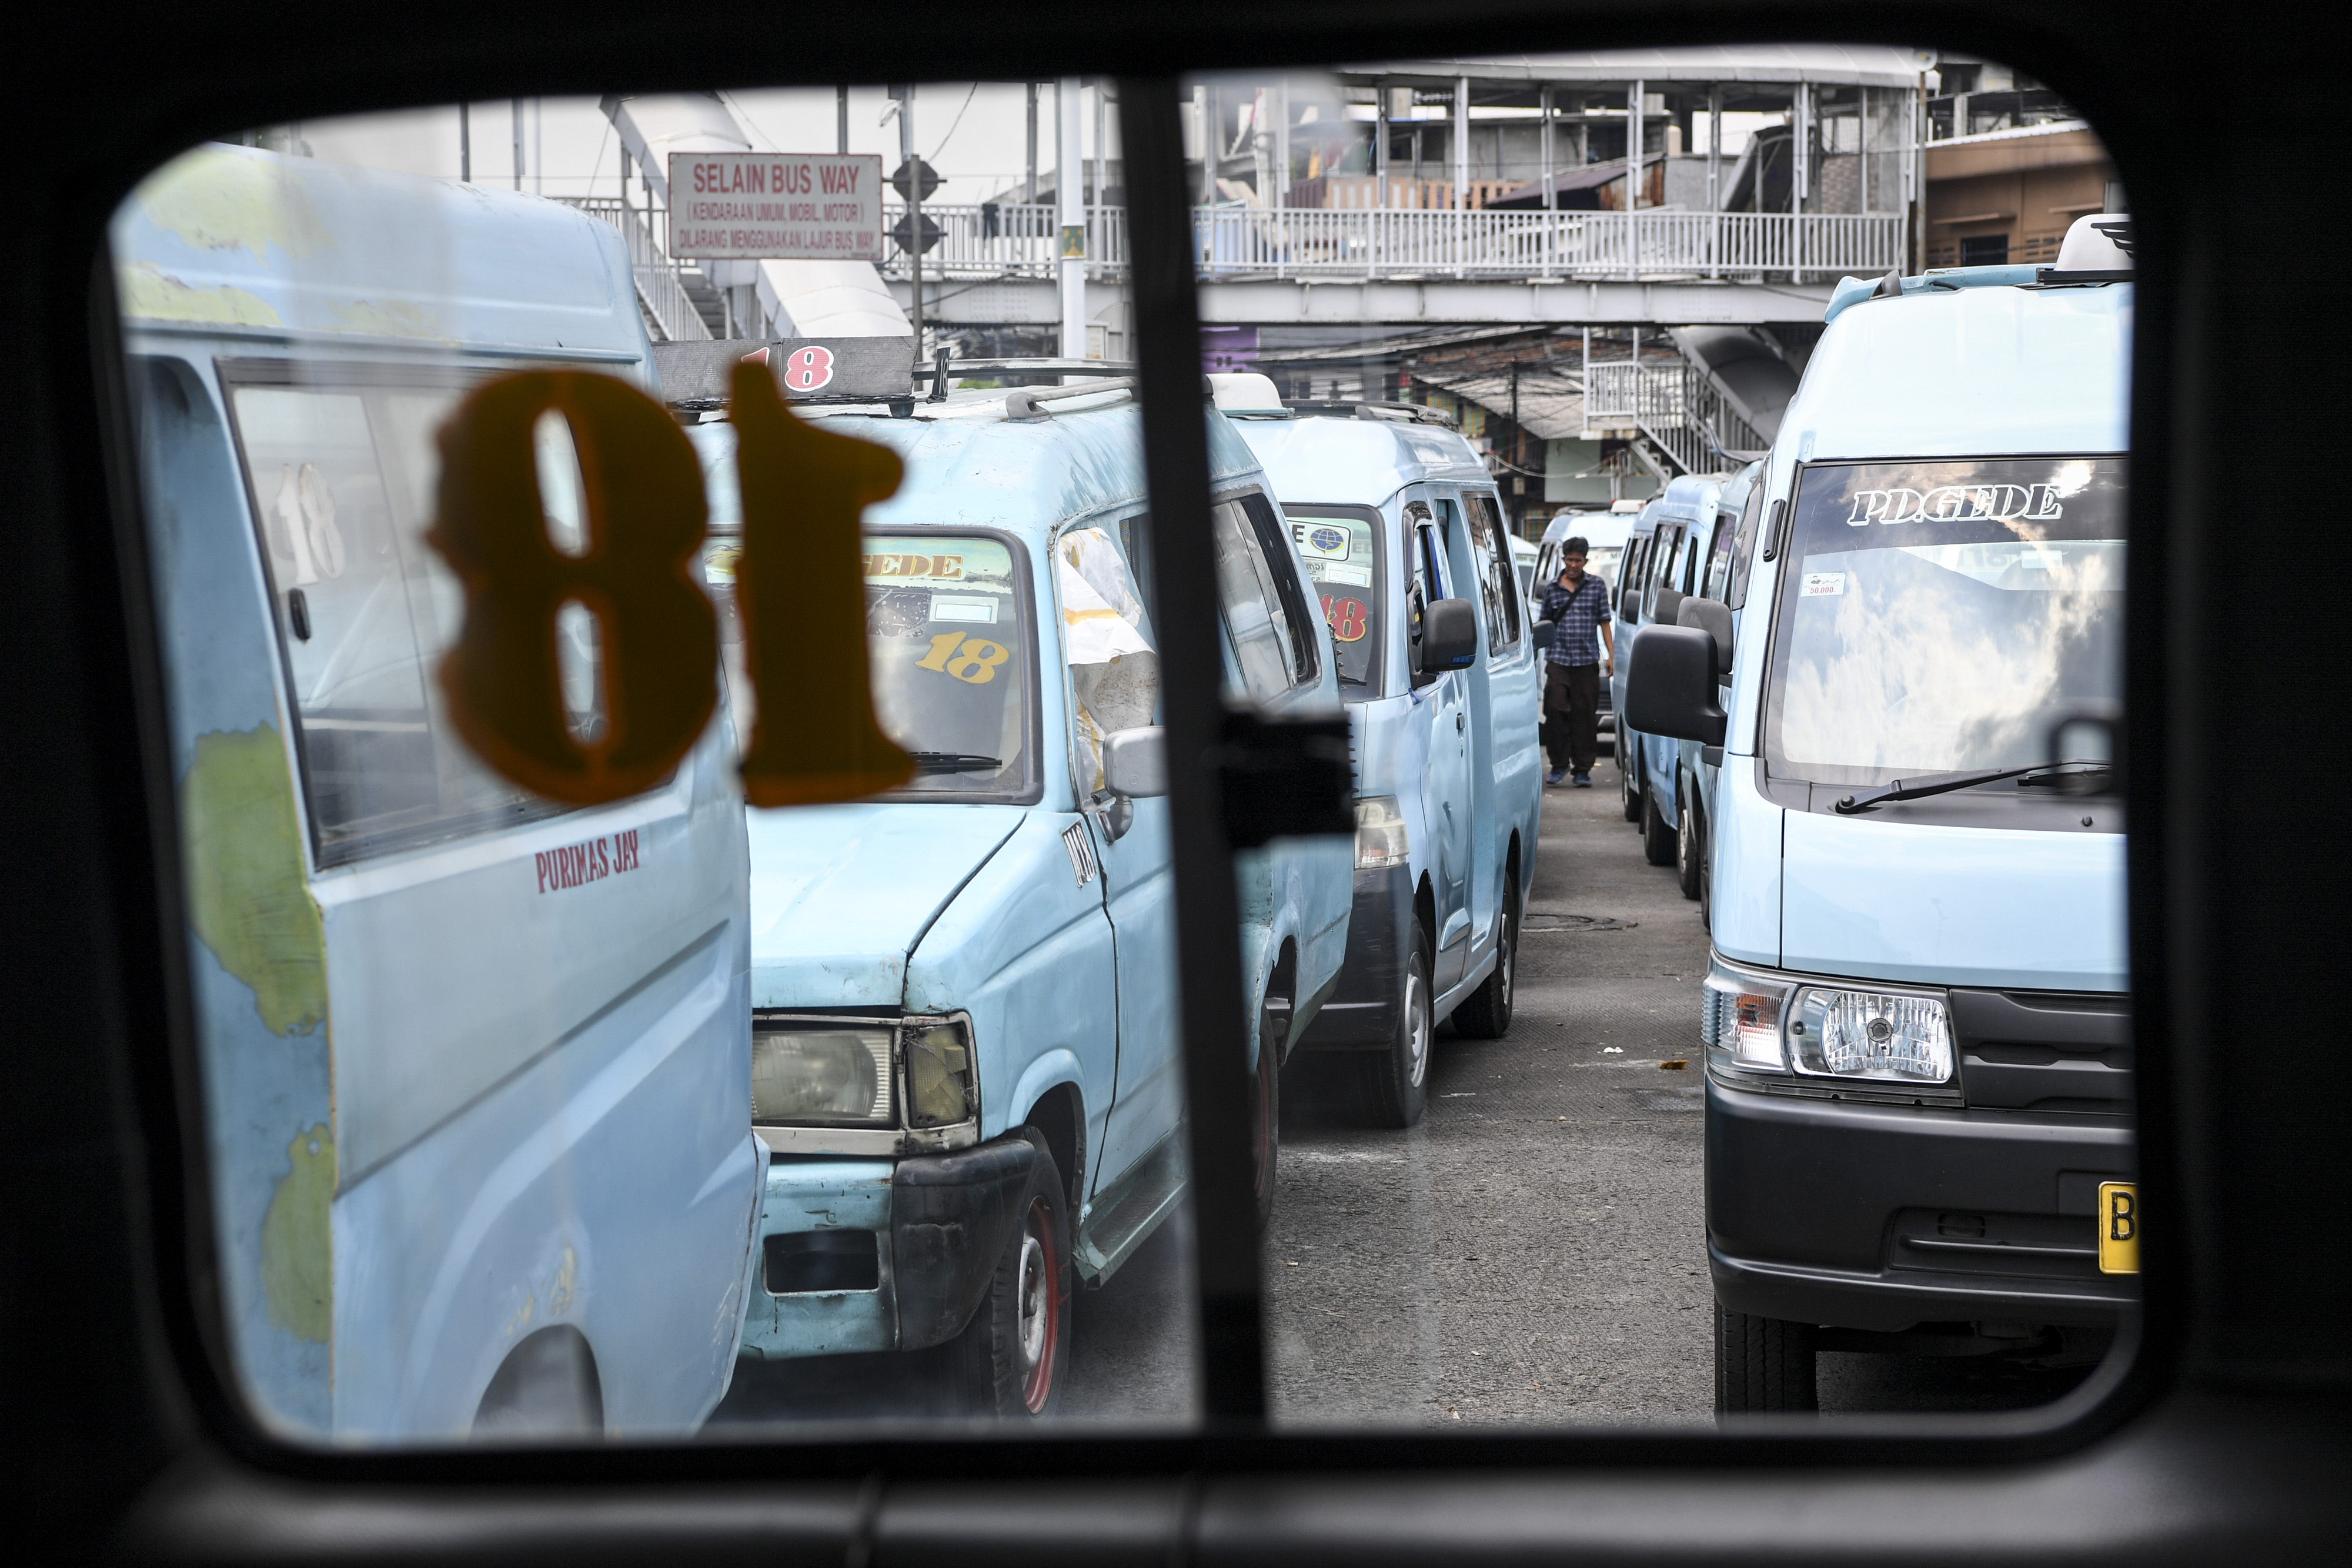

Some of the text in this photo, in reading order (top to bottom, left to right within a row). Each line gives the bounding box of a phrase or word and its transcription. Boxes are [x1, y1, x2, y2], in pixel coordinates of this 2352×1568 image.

[693, 163, 860, 195] SELAIN BUS WAY
[679, 229, 875, 250] DILARANG MENGGUNAKAN LAJUR BUS WAY
[938, 357, 949, 394] 18
[1846, 483, 2063, 527] PD.GEDE
[915, 631, 1010, 684] 18
[534, 829, 639, 894] PURIMAS JAY
[2111, 1191, 2135, 1241] B
